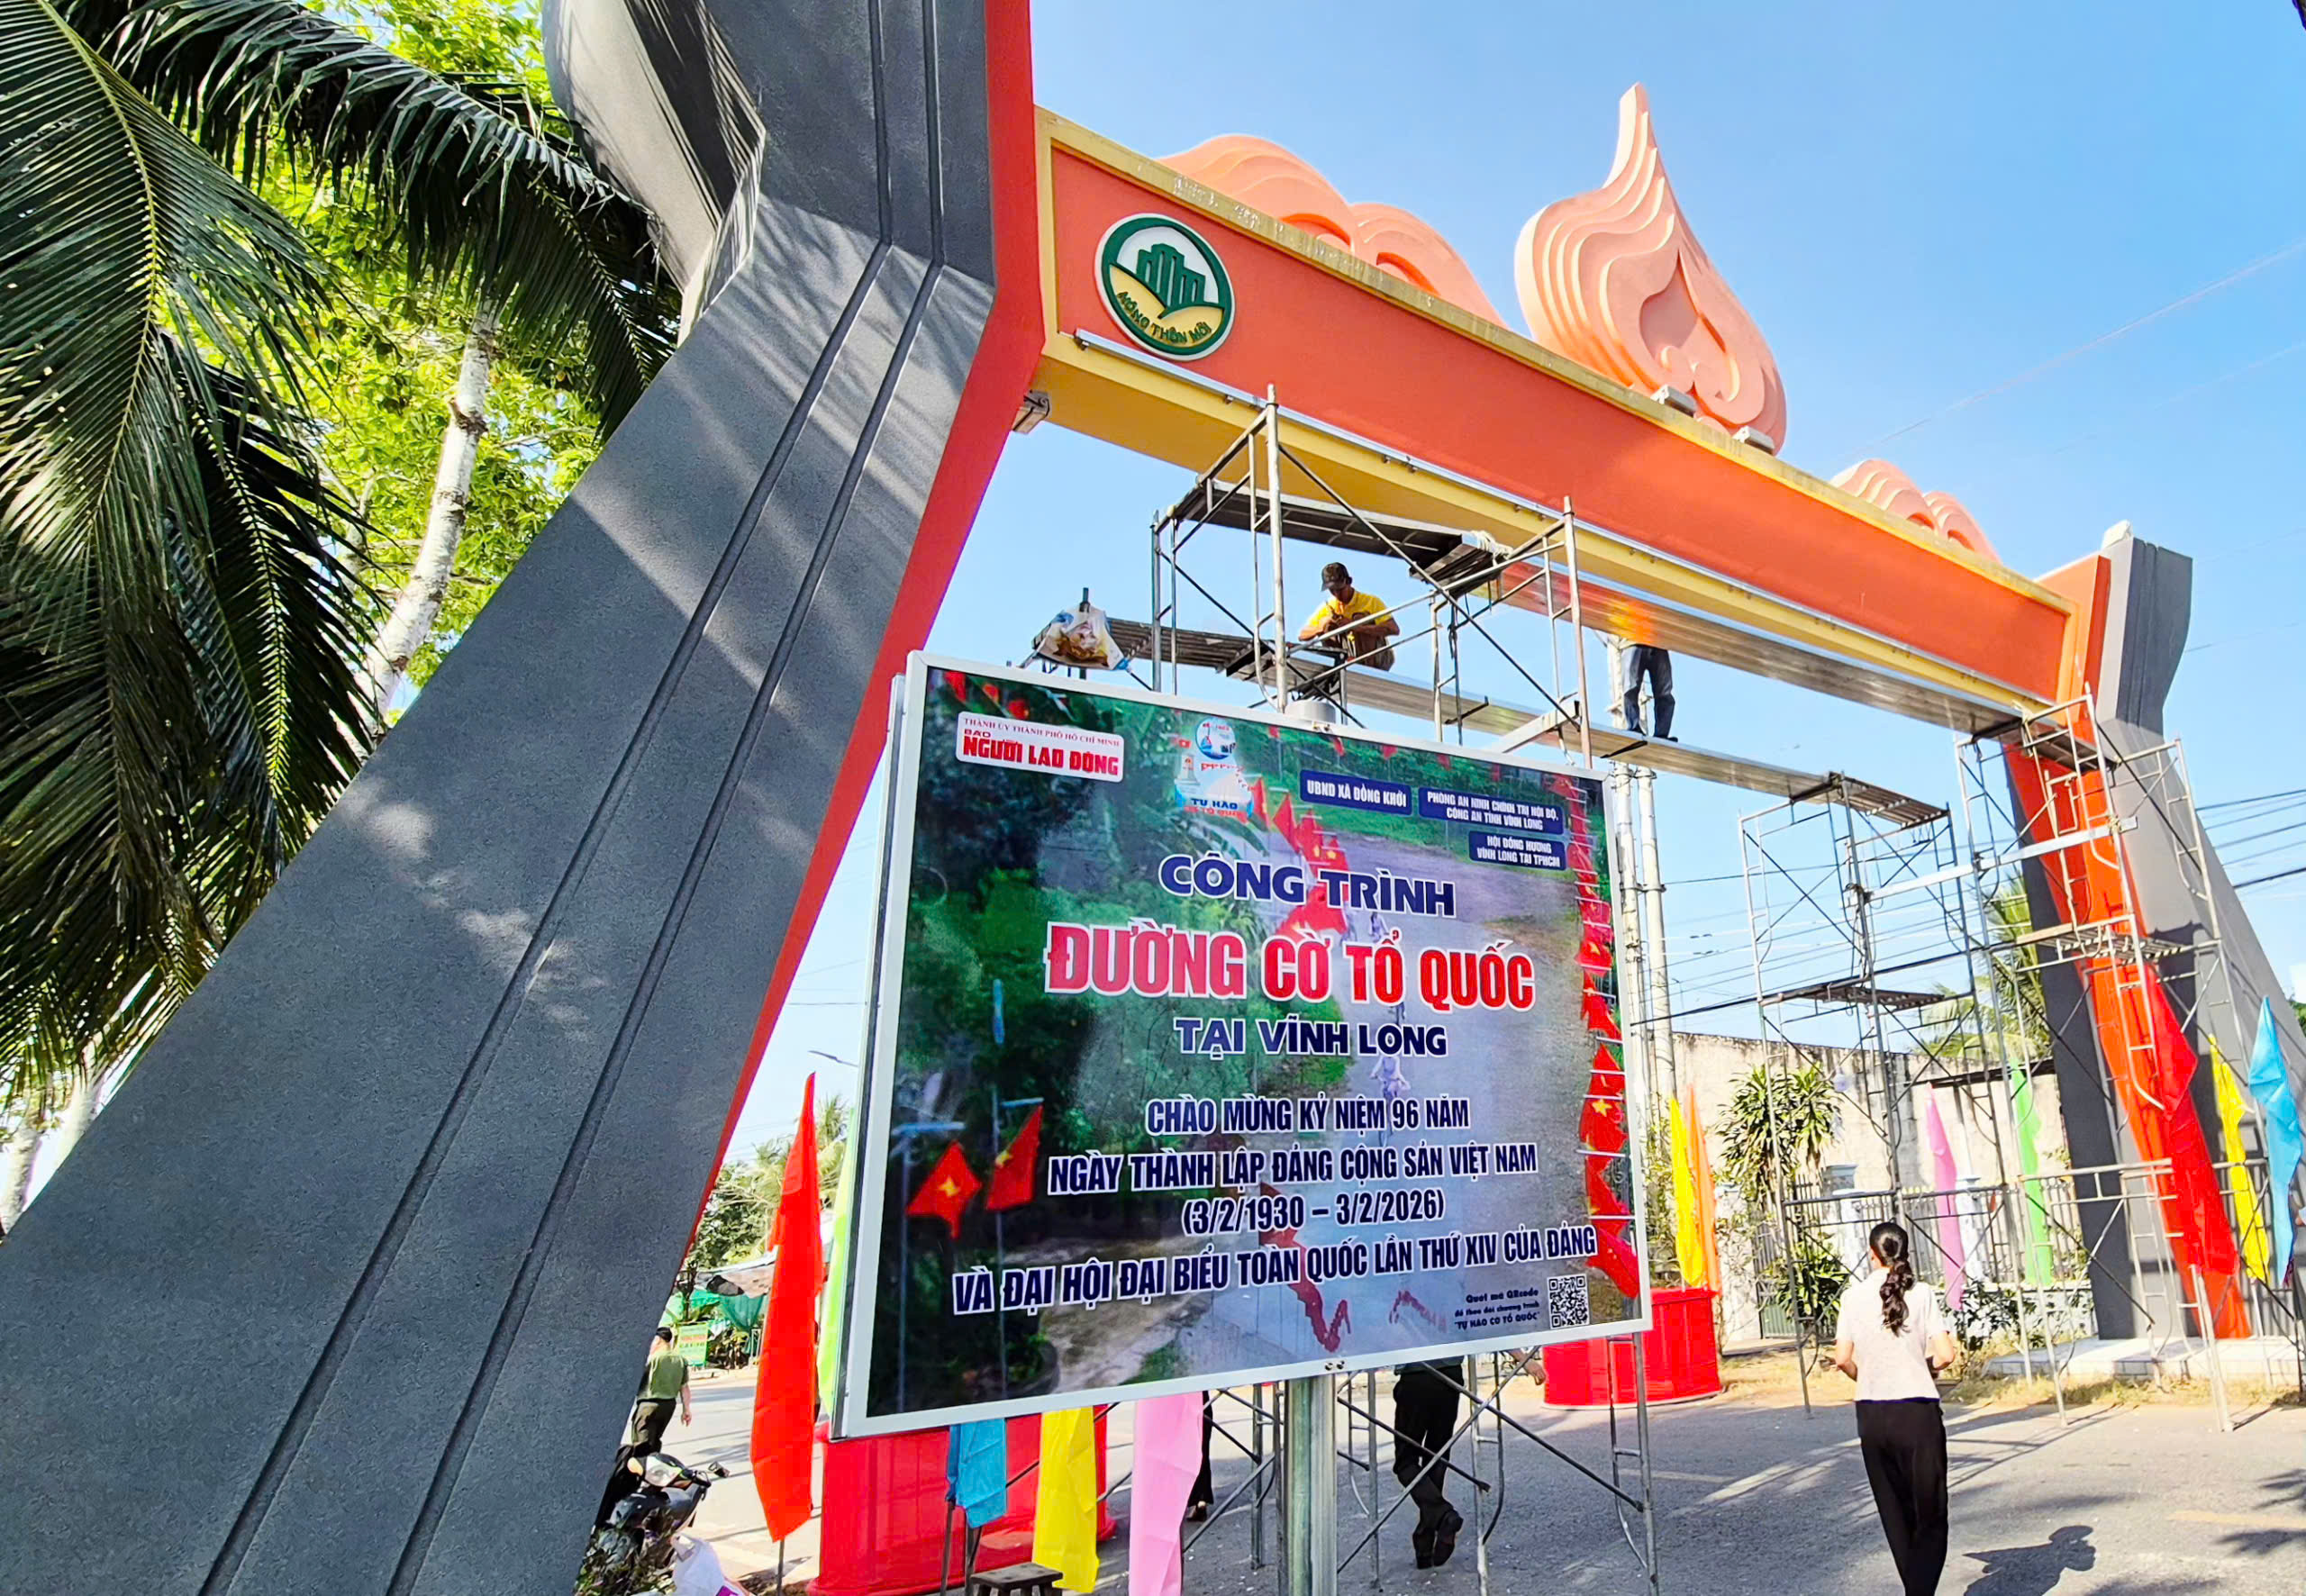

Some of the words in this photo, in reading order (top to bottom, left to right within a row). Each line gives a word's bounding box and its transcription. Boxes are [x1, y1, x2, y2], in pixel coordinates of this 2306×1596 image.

[1118, 291, 1150, 328] NÔNG
[1151, 323, 1188, 345] THÔN
[963, 735, 1023, 764] NGƯỜI
[1028, 744, 1065, 769] LAO
[965, 718, 996, 730] THÀNH
[1012, 724, 1044, 737] THÀNH
[1097, 739, 1120, 748] MINH
[1306, 779, 1336, 798] UBND
[1353, 783, 1381, 803] ĐỒNG
[1427, 791, 1456, 805] PHÒNG
[1457, 795, 1469, 807] AN
[1446, 806, 1469, 821] CÔNG
[1470, 811, 1483, 821] AN
[1523, 819, 1544, 831] LONG
[1487, 835, 1501, 848] HỘI
[1497, 851, 1518, 863] LONG
[1519, 853, 1532, 866] TẠI
[1533, 855, 1561, 867] TPHCM
[1159, 851, 1305, 904] CÔNG
[1320, 869, 1455, 917] TRÌNH
[1046, 918, 1247, 999] ĐƯỜNG
[1262, 927, 1333, 1002] CỜ
[1345, 928, 1405, 1004] TỔ
[1421, 940, 1535, 1012] QUỐC
[1174, 1018, 1245, 1060] TẠI
[1257, 1015, 1348, 1056] VĨNH
[1358, 1025, 1447, 1056] LONG
[1147, 1093, 1216, 1135] CHÀO
[1221, 1093, 1292, 1132] MỪNG
[1298, 1093, 1328, 1131] KỶ
[1335, 1095, 1385, 1137] NIỆM
[1392, 1098, 1420, 1129] 96
[1425, 1093, 1470, 1129] NĂM
[1049, 1150, 1123, 1195] NGÀY
[1130, 1148, 1214, 1191] THÀNH
[1221, 1147, 1266, 1192] LẬP
[1272, 1144, 1332, 1183] ĐẢNG
[1339, 1145, 1397, 1186] CỘNG
[1403, 1139, 1443, 1177] SẢN
[1448, 1142, 1488, 1181] VIỆT
[1494, 1143, 1537, 1173] NAM
[1182, 1195, 1304, 1236] (3/2/1930
[1335, 1189, 1446, 1226] 3/2/2026)
[953, 1266, 994, 1314] VÀ
[1001, 1266, 1055, 1315] ĐẠI
[1061, 1258, 1112, 1310] HỘI
[1119, 1259, 1167, 1304] ĐẠI
[1172, 1244, 1231, 1293] BIỂU
[1236, 1246, 1300, 1286] TOÀN
[1306, 1235, 1367, 1283] QUỐC
[1374, 1233, 1412, 1274] LẦN
[1418, 1231, 1461, 1269] THỨ
[1465, 1233, 1498, 1266] XIV
[1503, 1224, 1541, 1263] CỦA
[1547, 1221, 1598, 1258] ĐẢNG
